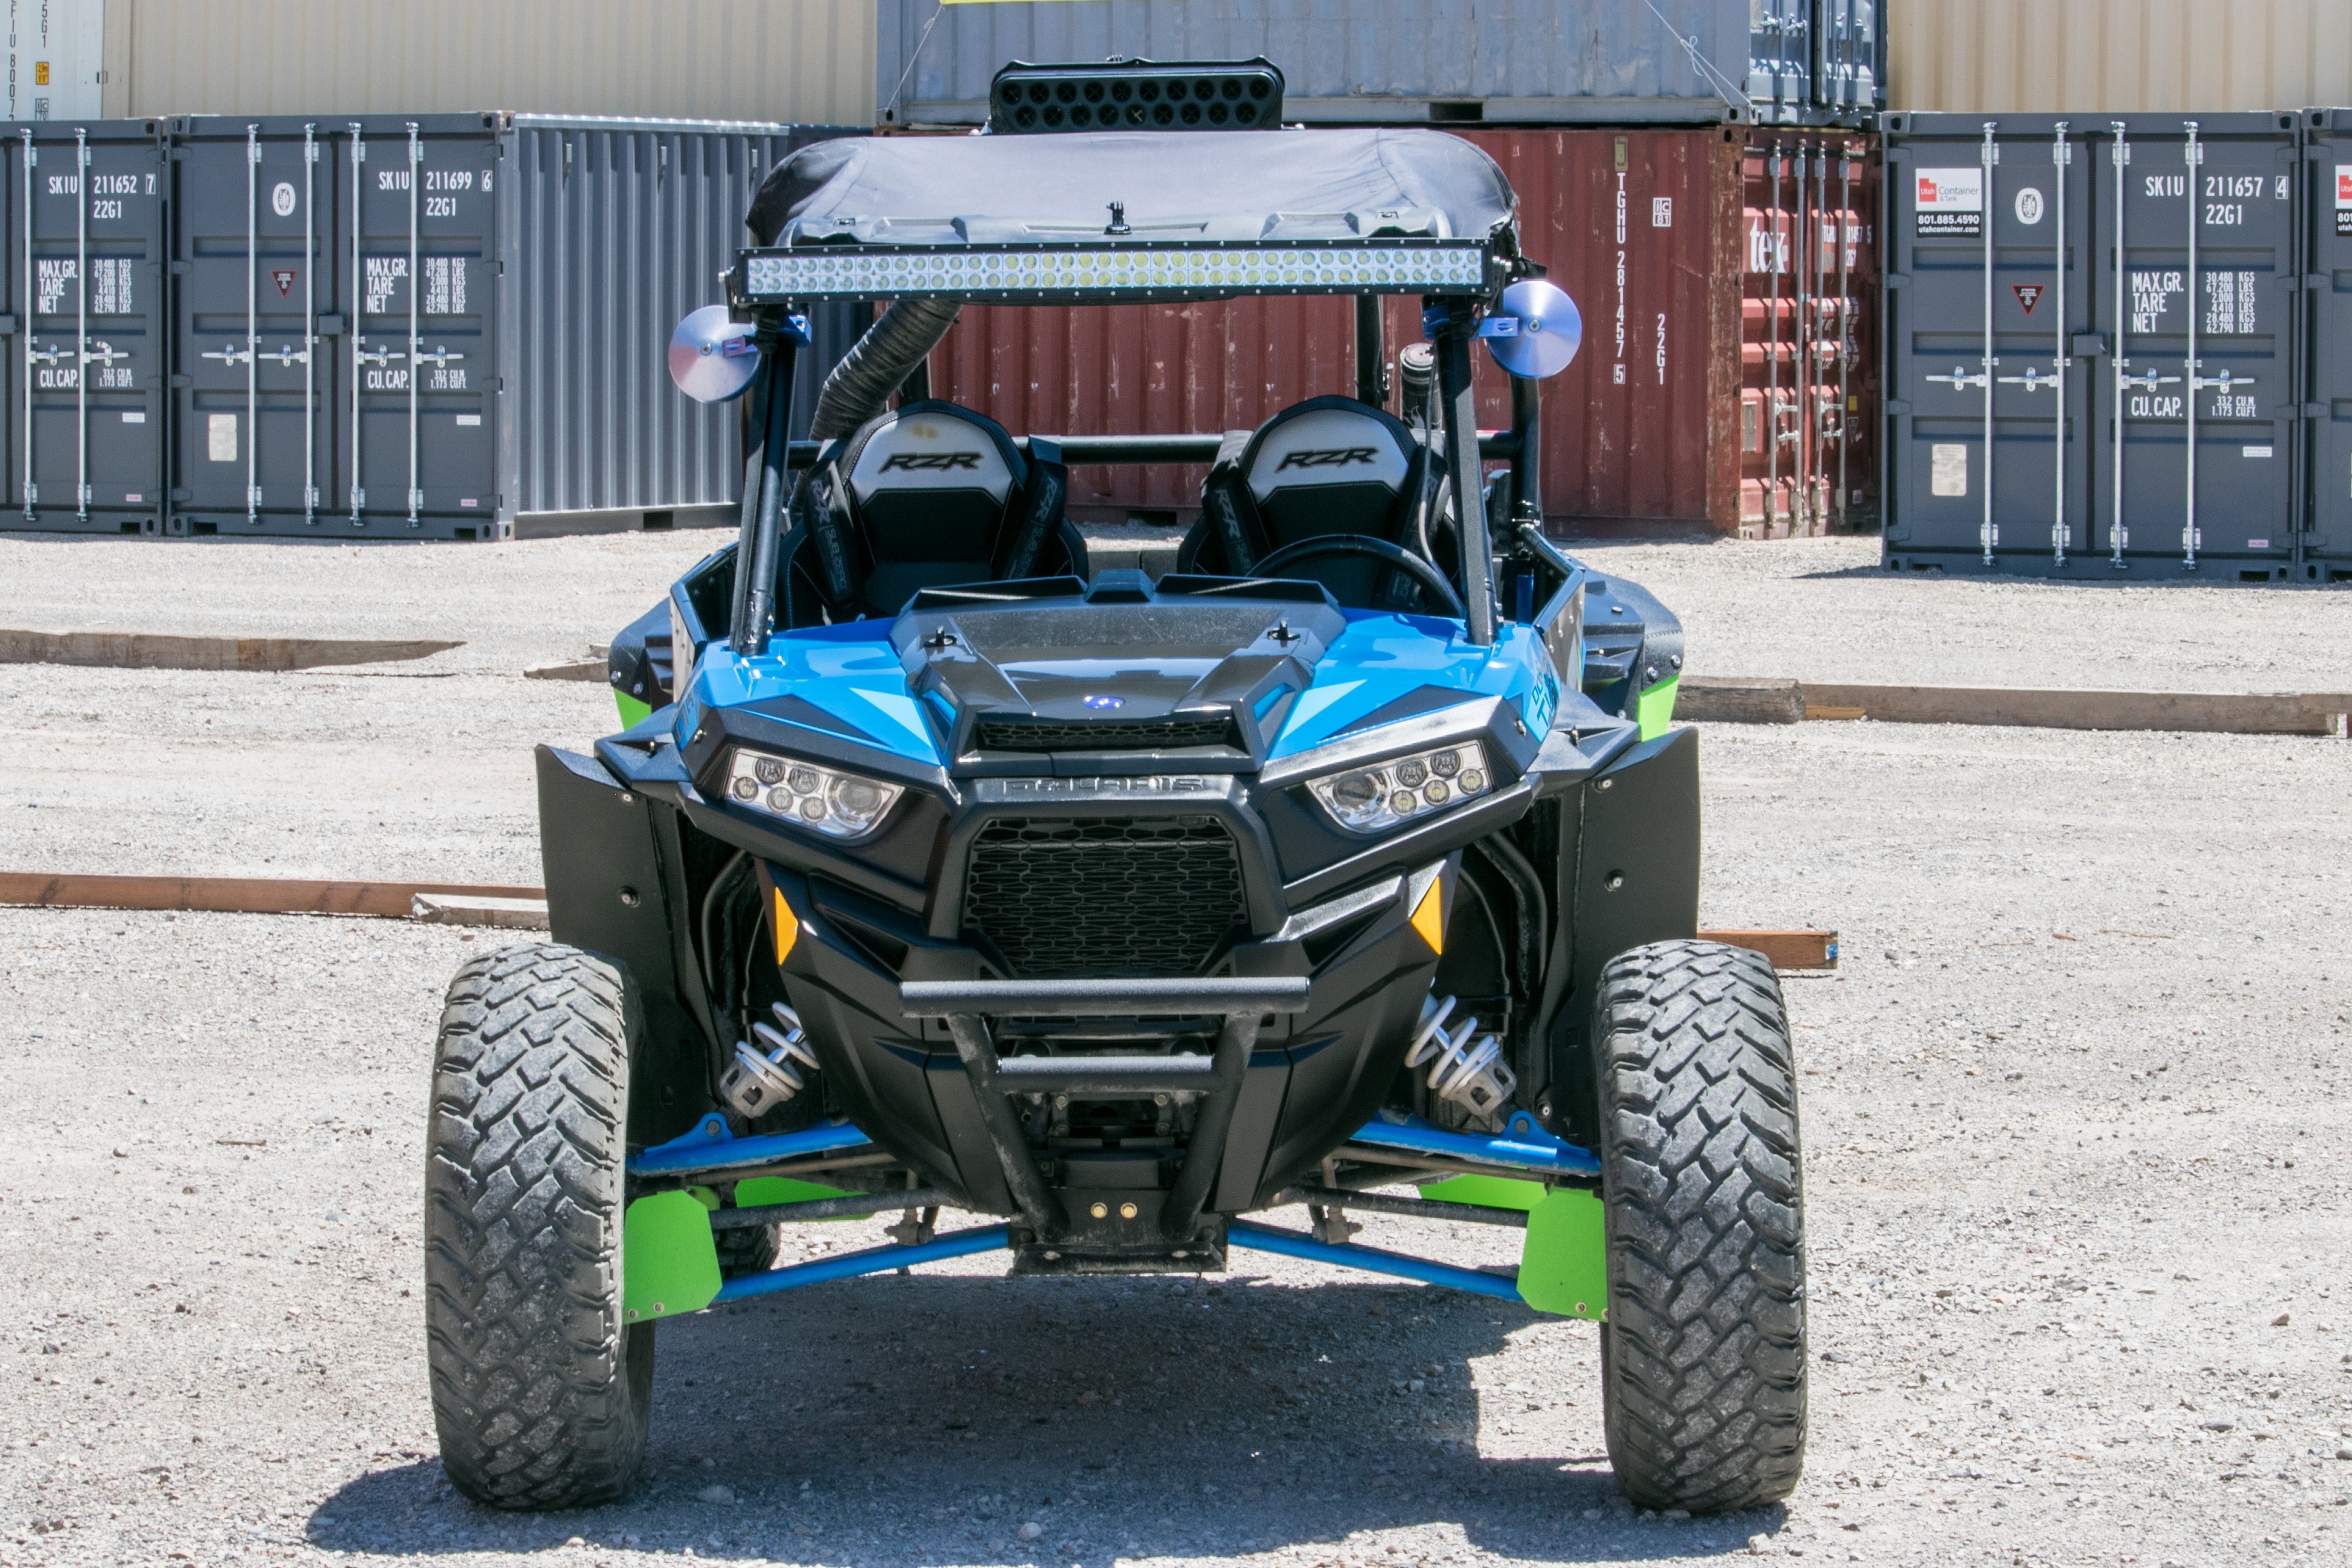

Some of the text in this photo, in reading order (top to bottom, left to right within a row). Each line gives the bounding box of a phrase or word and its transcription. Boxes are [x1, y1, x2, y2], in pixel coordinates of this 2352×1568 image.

[49, 175, 154, 194] SKIU 211652 7
[379, 171, 491, 191] SKIU 211699 6
[2146, 176, 2287, 198] SKIU 211657 4
[1939, 187, 1978, 195] Container
[94, 200, 122, 218] 22G1
[426, 198, 456, 216] 22G1
[1656, 215, 1669, 225] 81
[1918, 215, 1979, 224] 801.885.4590
[2206, 204, 2242, 225] 22G1
[1749, 216, 1786, 274] tex
[39, 260, 78, 278] MAX.GR.
[94, 259, 132, 269] 30.480 KGS
[367, 258, 408, 276] MAX.GR.
[426, 258, 466, 268] 30.480 KGS
[94, 269, 131, 278] 67.200 LBS
[426, 268, 465, 277] 67.200 LBS
[1615, 172, 1625, 384] TGHU 281457 5
[2206, 272, 2255, 282] 30.480 KGS
[40, 278, 65, 296] TARE
[99, 278, 132, 286] 2.000 KGS
[368, 277, 395, 295] TARE
[431, 276, 466, 286] 2.000 KGS
[2132, 272, 2184, 292] MAX.GR.
[2206, 282, 2254, 293] 67.200 LBS
[99, 286, 131, 295] 4.410 LBS
[431, 286, 465, 295] 4.410 LBS
[39, 296, 58, 314] NET
[94, 295, 132, 304] 28.480 KGS
[366, 295, 387, 313] NET
[426, 295, 466, 304] 28.480 KGS
[2132, 293, 2167, 313] TARE
[2211, 293, 2255, 303] 2.000 KGS
[94, 304, 131, 314] 62.790 LBS
[426, 304, 465, 314] 62.790 LBS
[2211, 303, 2254, 313] 4.410 LBS
[2132, 313, 2157, 333] NET
[2206, 313, 2255, 323] 28.480 KGS
[2206, 323, 2254, 333] 62.790 LBS
[1657, 313, 1665, 385] 22G1
[99, 377, 114, 387] 1.173
[431, 379, 447, 389] 1.173
[2212, 406, 2232, 417] 1.173
[878, 453, 984, 474] RZR
[1274, 446, 1380, 473] RZR
[811, 479, 831, 524] RZR
[1035, 476, 1057, 522] RZR
[1215, 489, 1241, 538] RZR
[1003, 777, 1203, 794] POLARIS
